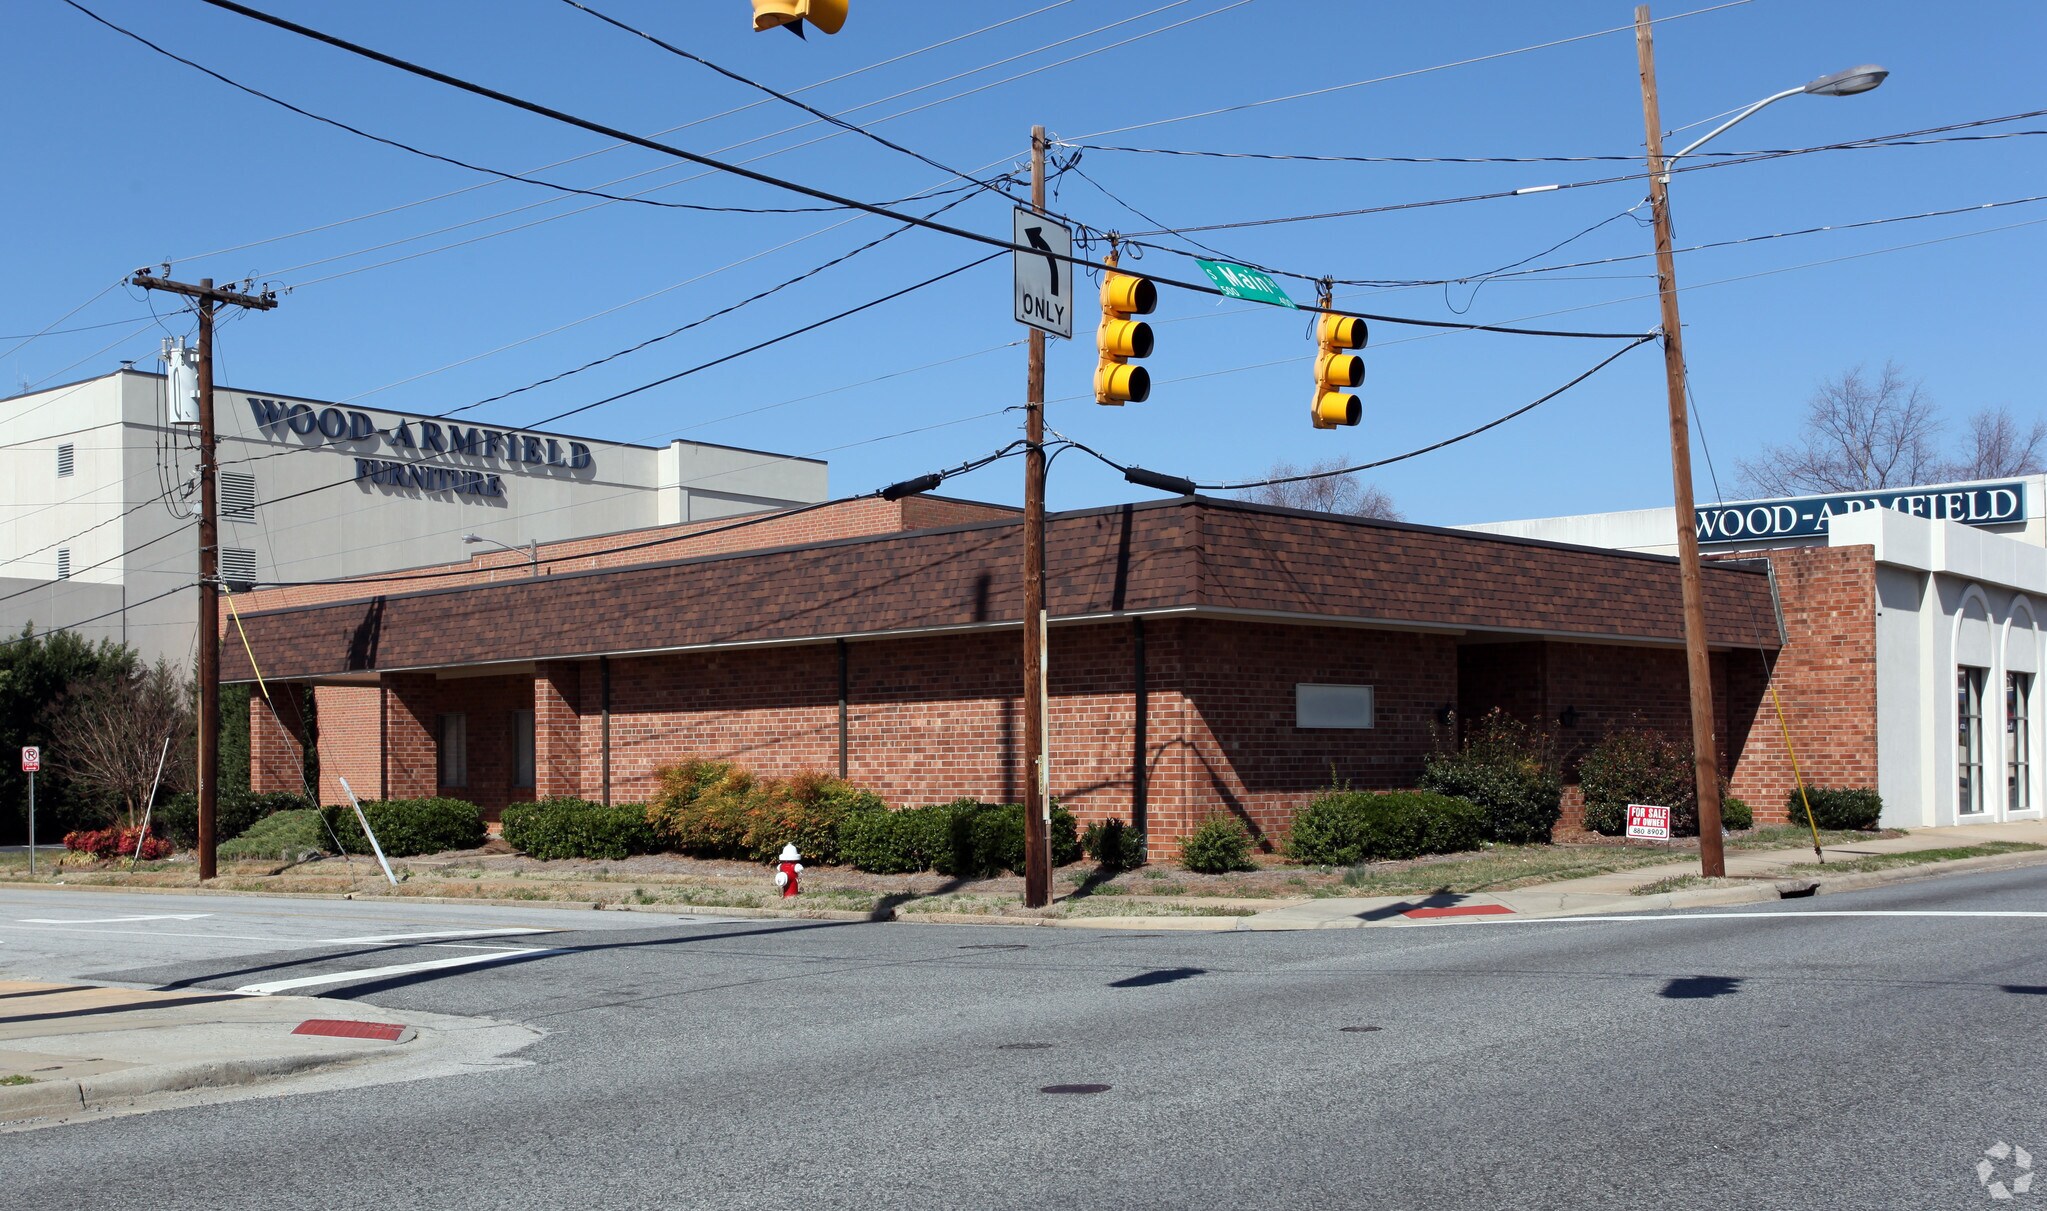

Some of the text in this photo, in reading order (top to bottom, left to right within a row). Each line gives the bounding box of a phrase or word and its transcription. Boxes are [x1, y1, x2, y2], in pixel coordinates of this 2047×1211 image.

[1205, 268, 1218, 281] S
[1216, 265, 1274, 294] Main
[1220, 285, 1241, 298] 500
[1023, 293, 1065, 325] ONLY
[246, 397, 592, 470] WOOD-ARMFIELD
[353, 457, 502, 498] FURNITURE
[1631, 807, 1667, 819] FOR SALE
[1632, 817, 1665, 827] BY OWNER
